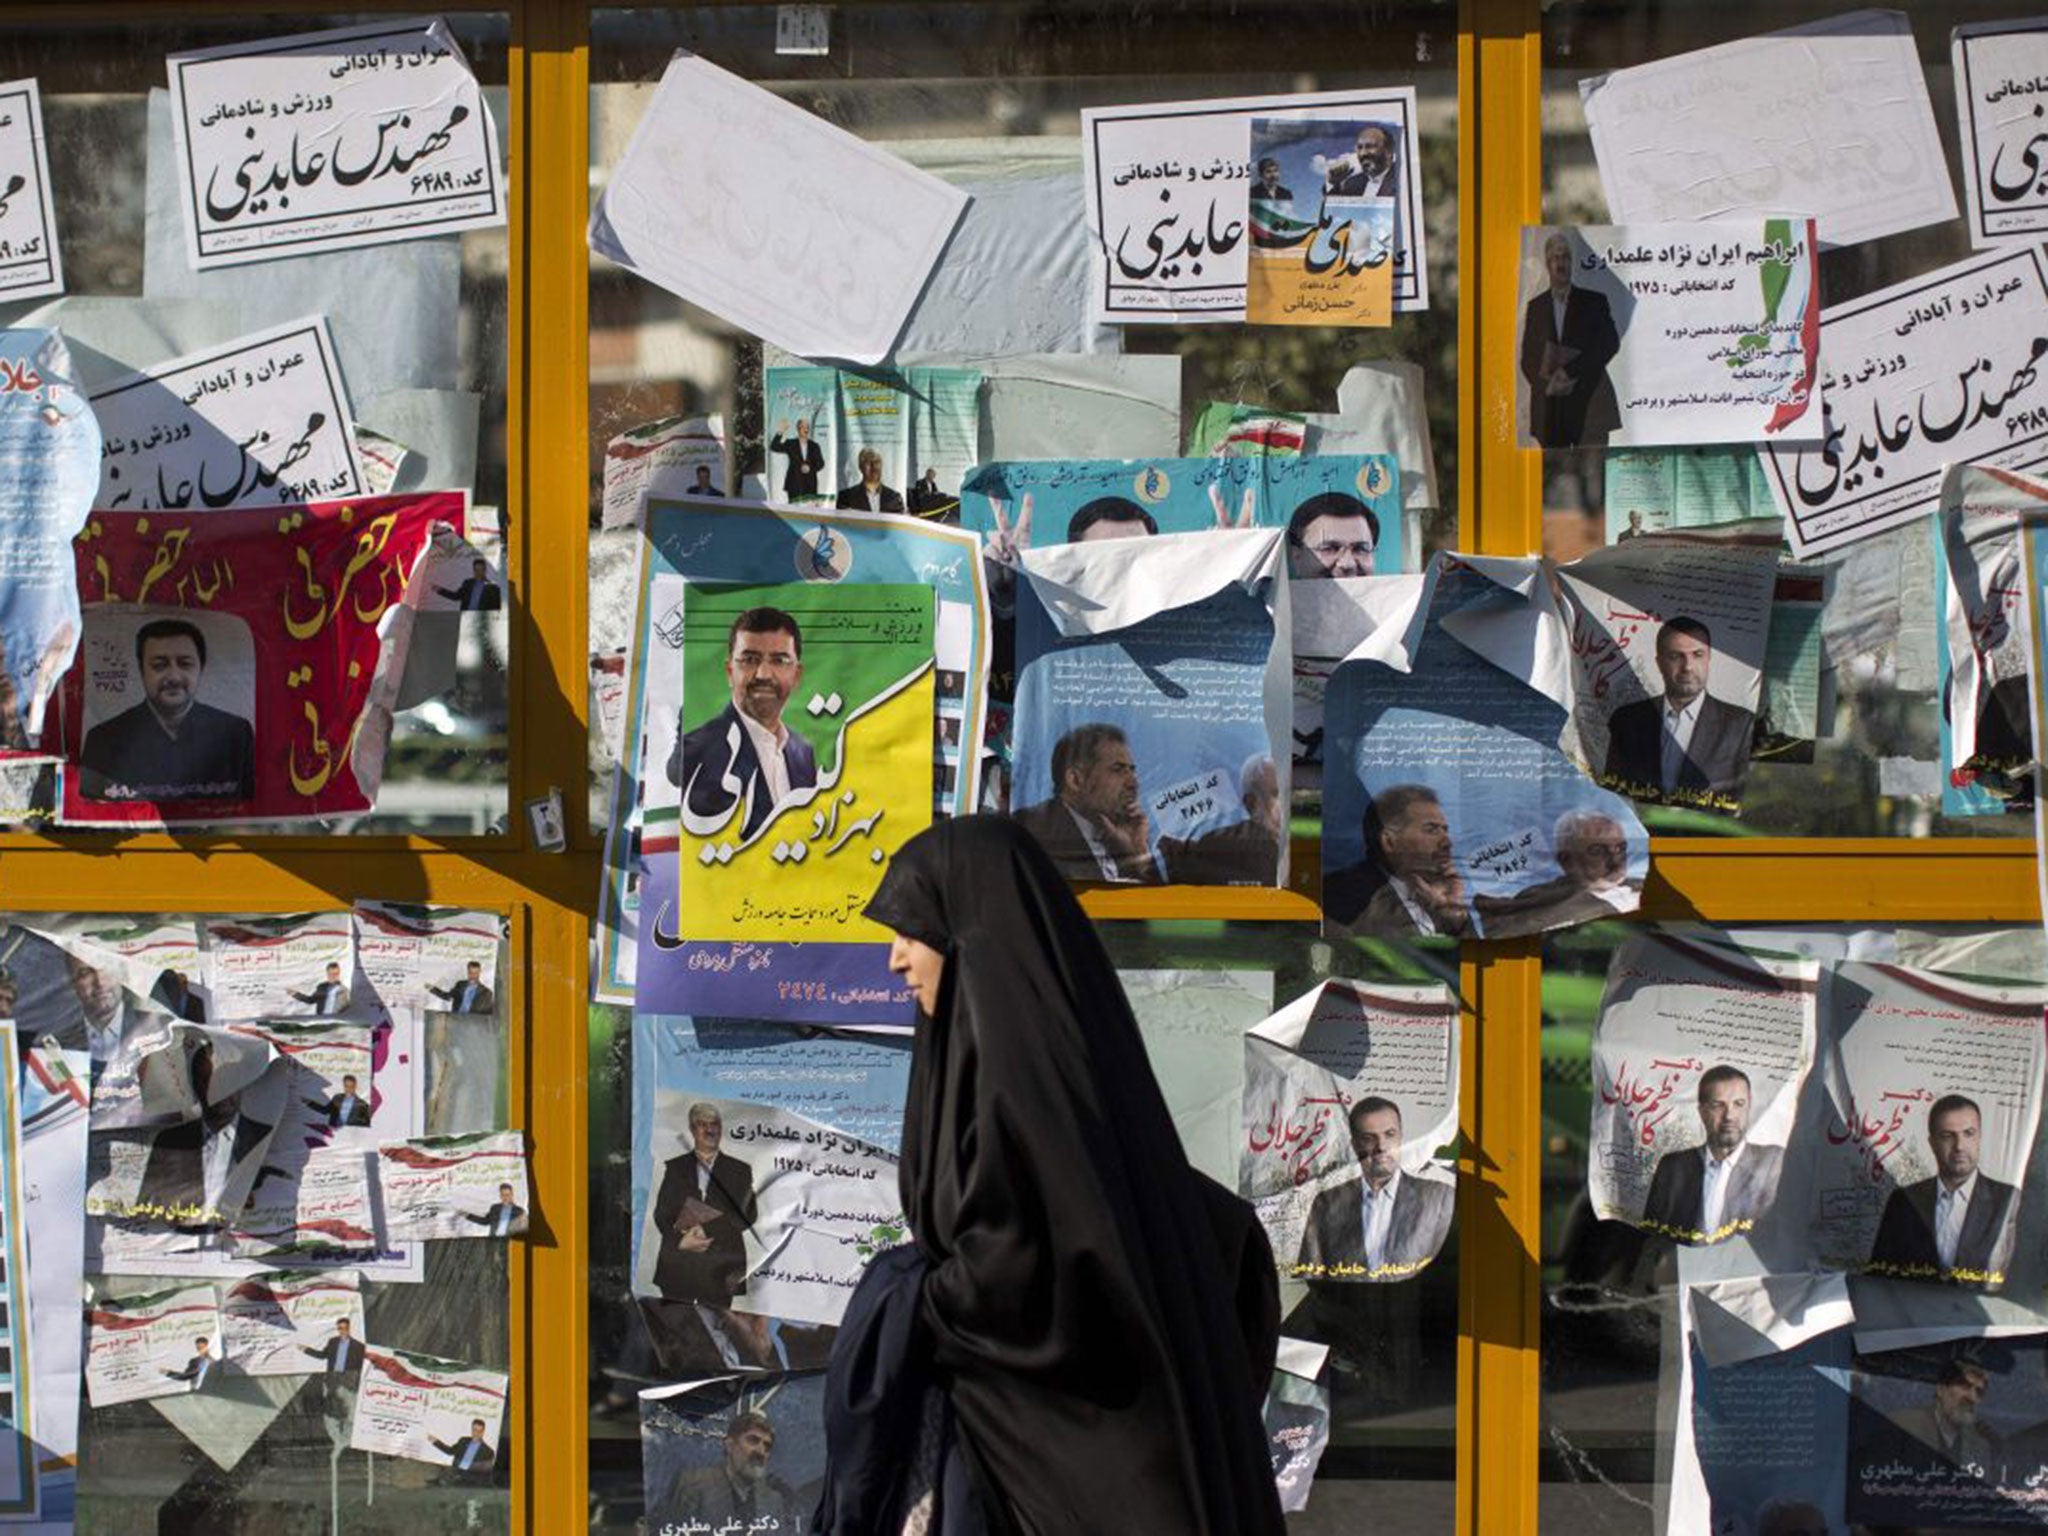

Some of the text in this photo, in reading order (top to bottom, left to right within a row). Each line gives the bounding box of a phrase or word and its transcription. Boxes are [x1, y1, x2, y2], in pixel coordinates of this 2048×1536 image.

[329, 48, 388, 78] آبادانی
[395, 54, 404, 70] و
[200, 93, 333, 127] ورزش و شادمانی
[205, 105, 470, 222] مهندس عابدینی
[1113, 161, 1182, 187] شادمانی
[1187, 168, 1198, 183] و
[410, 171, 455, 196] ۶۴۸۹
[1116, 187, 1245, 281] عابدینی
[1253, 184, 1393, 278] صدای ملت
[1579, 241, 1804, 271] ابراهیم ایران نژاد علمداری
[1629, 278, 1737, 296] کد انتخاباتی ۱۹۷۵
[1895, 275, 2023, 337] عمران و آبادانی
[1664, 329, 1689, 340] دوره
[1706, 346, 1742, 362] اسلامی
[182, 354, 305, 406] عمران و آبادانی
[1766, 371, 1792, 382] حوزه
[1843, 353, 1907, 390] ورزش و
[1918, 337, 2048, 444] مهندس
[130, 420, 192, 456] ورزش و
[199, 412, 326, 508] مهندس
[1796, 397, 1914, 507] عابدینی
[1233, 461, 1261, 486] رونق
[1320, 466, 1339, 483] امید
[283, 507, 398, 641] حضرتی
[871, 623, 880, 635] و
[883, 622, 923, 637] ورزش
[1154, 776, 1219, 811] کد انتخاباتی
[809, 789, 885, 865] بهزاد
[1469, 832, 1534, 870] کد انتخاباتی
[732, 897, 763, 923] ورزش
[763, 908, 787, 926] جامعه
[788, 907, 817, 926] حمایت
[819, 907, 839, 919] مورد
[1649, 1056, 1704, 1072] دکتر
[1600, 1059, 1655, 1118] جلالی
[1879, 1086, 1936, 1102] دکتر
[730, 1123, 837, 1151] نژاد علمداری
[1249, 1099, 1308, 1160] جلالی
[773, 1156, 877, 1181] کد انتخاباتی ۱۹۷۵
[801, 1207, 824, 1219] دوره
[824, 1210, 855, 1222] دهمین
[839, 1232, 873, 1246] اسلامی
[1859, 1458, 1985, 1482] دکتر علی مطهری
[712, 1515, 743, 1536] علی
[748, 1514, 780, 1532] دکتر
